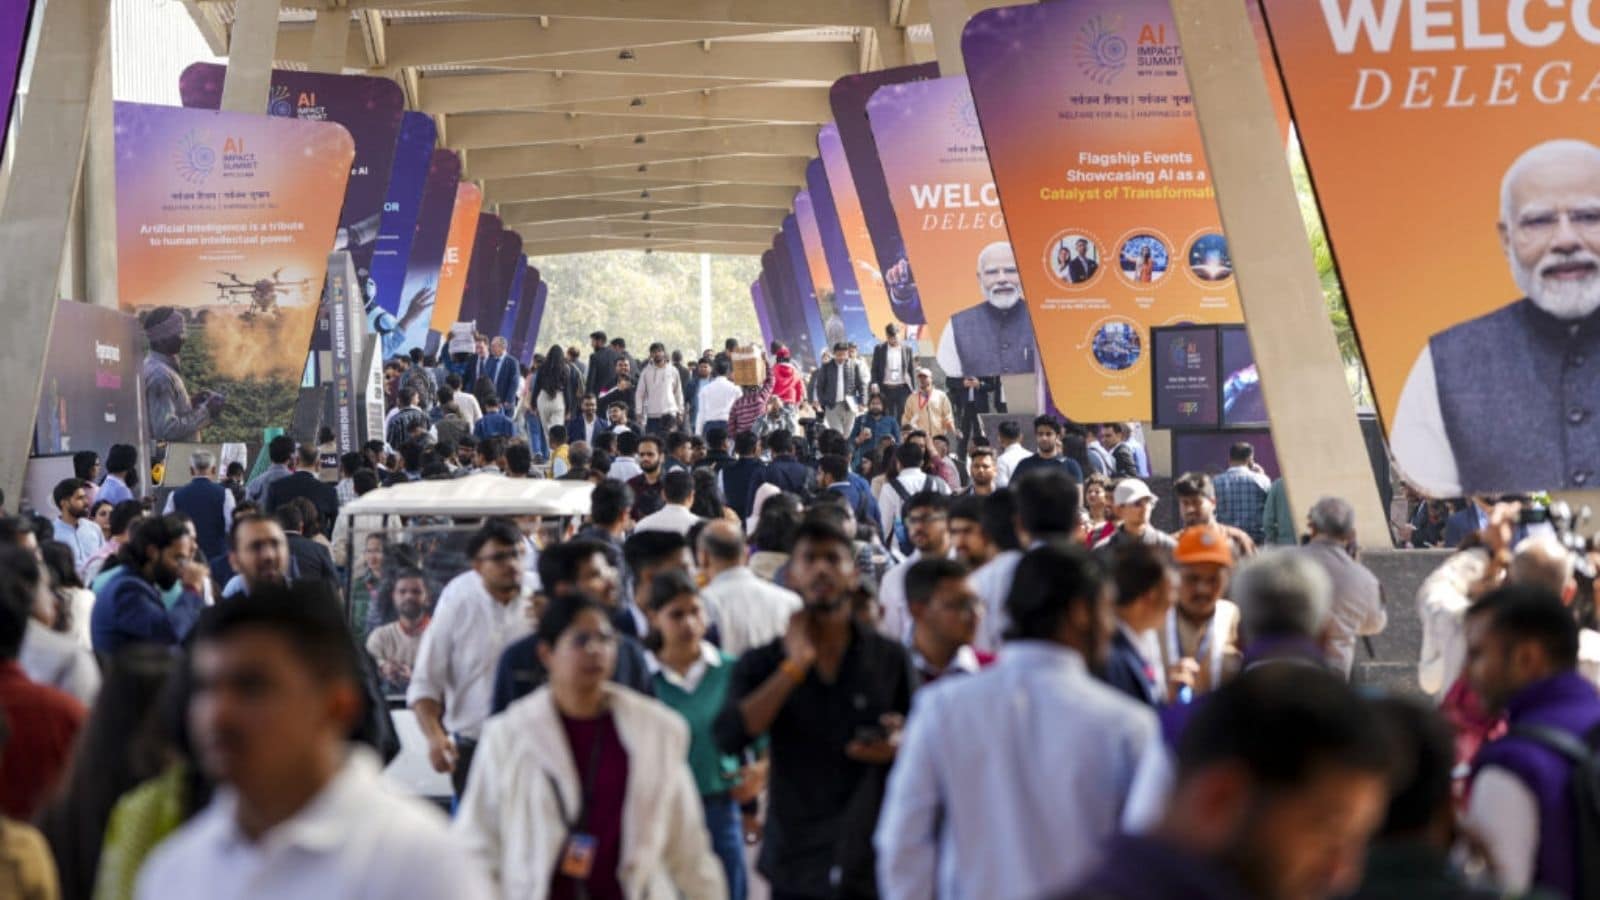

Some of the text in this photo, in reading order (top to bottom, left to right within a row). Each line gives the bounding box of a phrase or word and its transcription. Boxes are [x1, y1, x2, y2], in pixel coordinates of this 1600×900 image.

[1137, 23, 1166, 45] AI
[1137, 46, 1181, 56] IMPACT
[1137, 56, 1183, 66] SUMMIT
[297, 92, 316, 107] AI
[223, 136, 244, 153] AI
[1079, 152, 1193, 167] Flagship Events
[358, 166, 368, 175] AI
[1067, 169, 1206, 183] Showcasing AI as a
[910, 182, 1000, 209] WELC
[1039, 187, 1099, 201] Catalyst
[1103, 186, 1119, 199] of
[383, 202, 400, 212] OR
[140, 223, 185, 234] Artificial
[250, 222, 257, 232] is
[259, 223, 267, 231] a
[269, 221, 304, 231] tribute
[150, 236, 161, 246] to
[163, 236, 198, 246] human
[260, 234, 296, 246] power.
